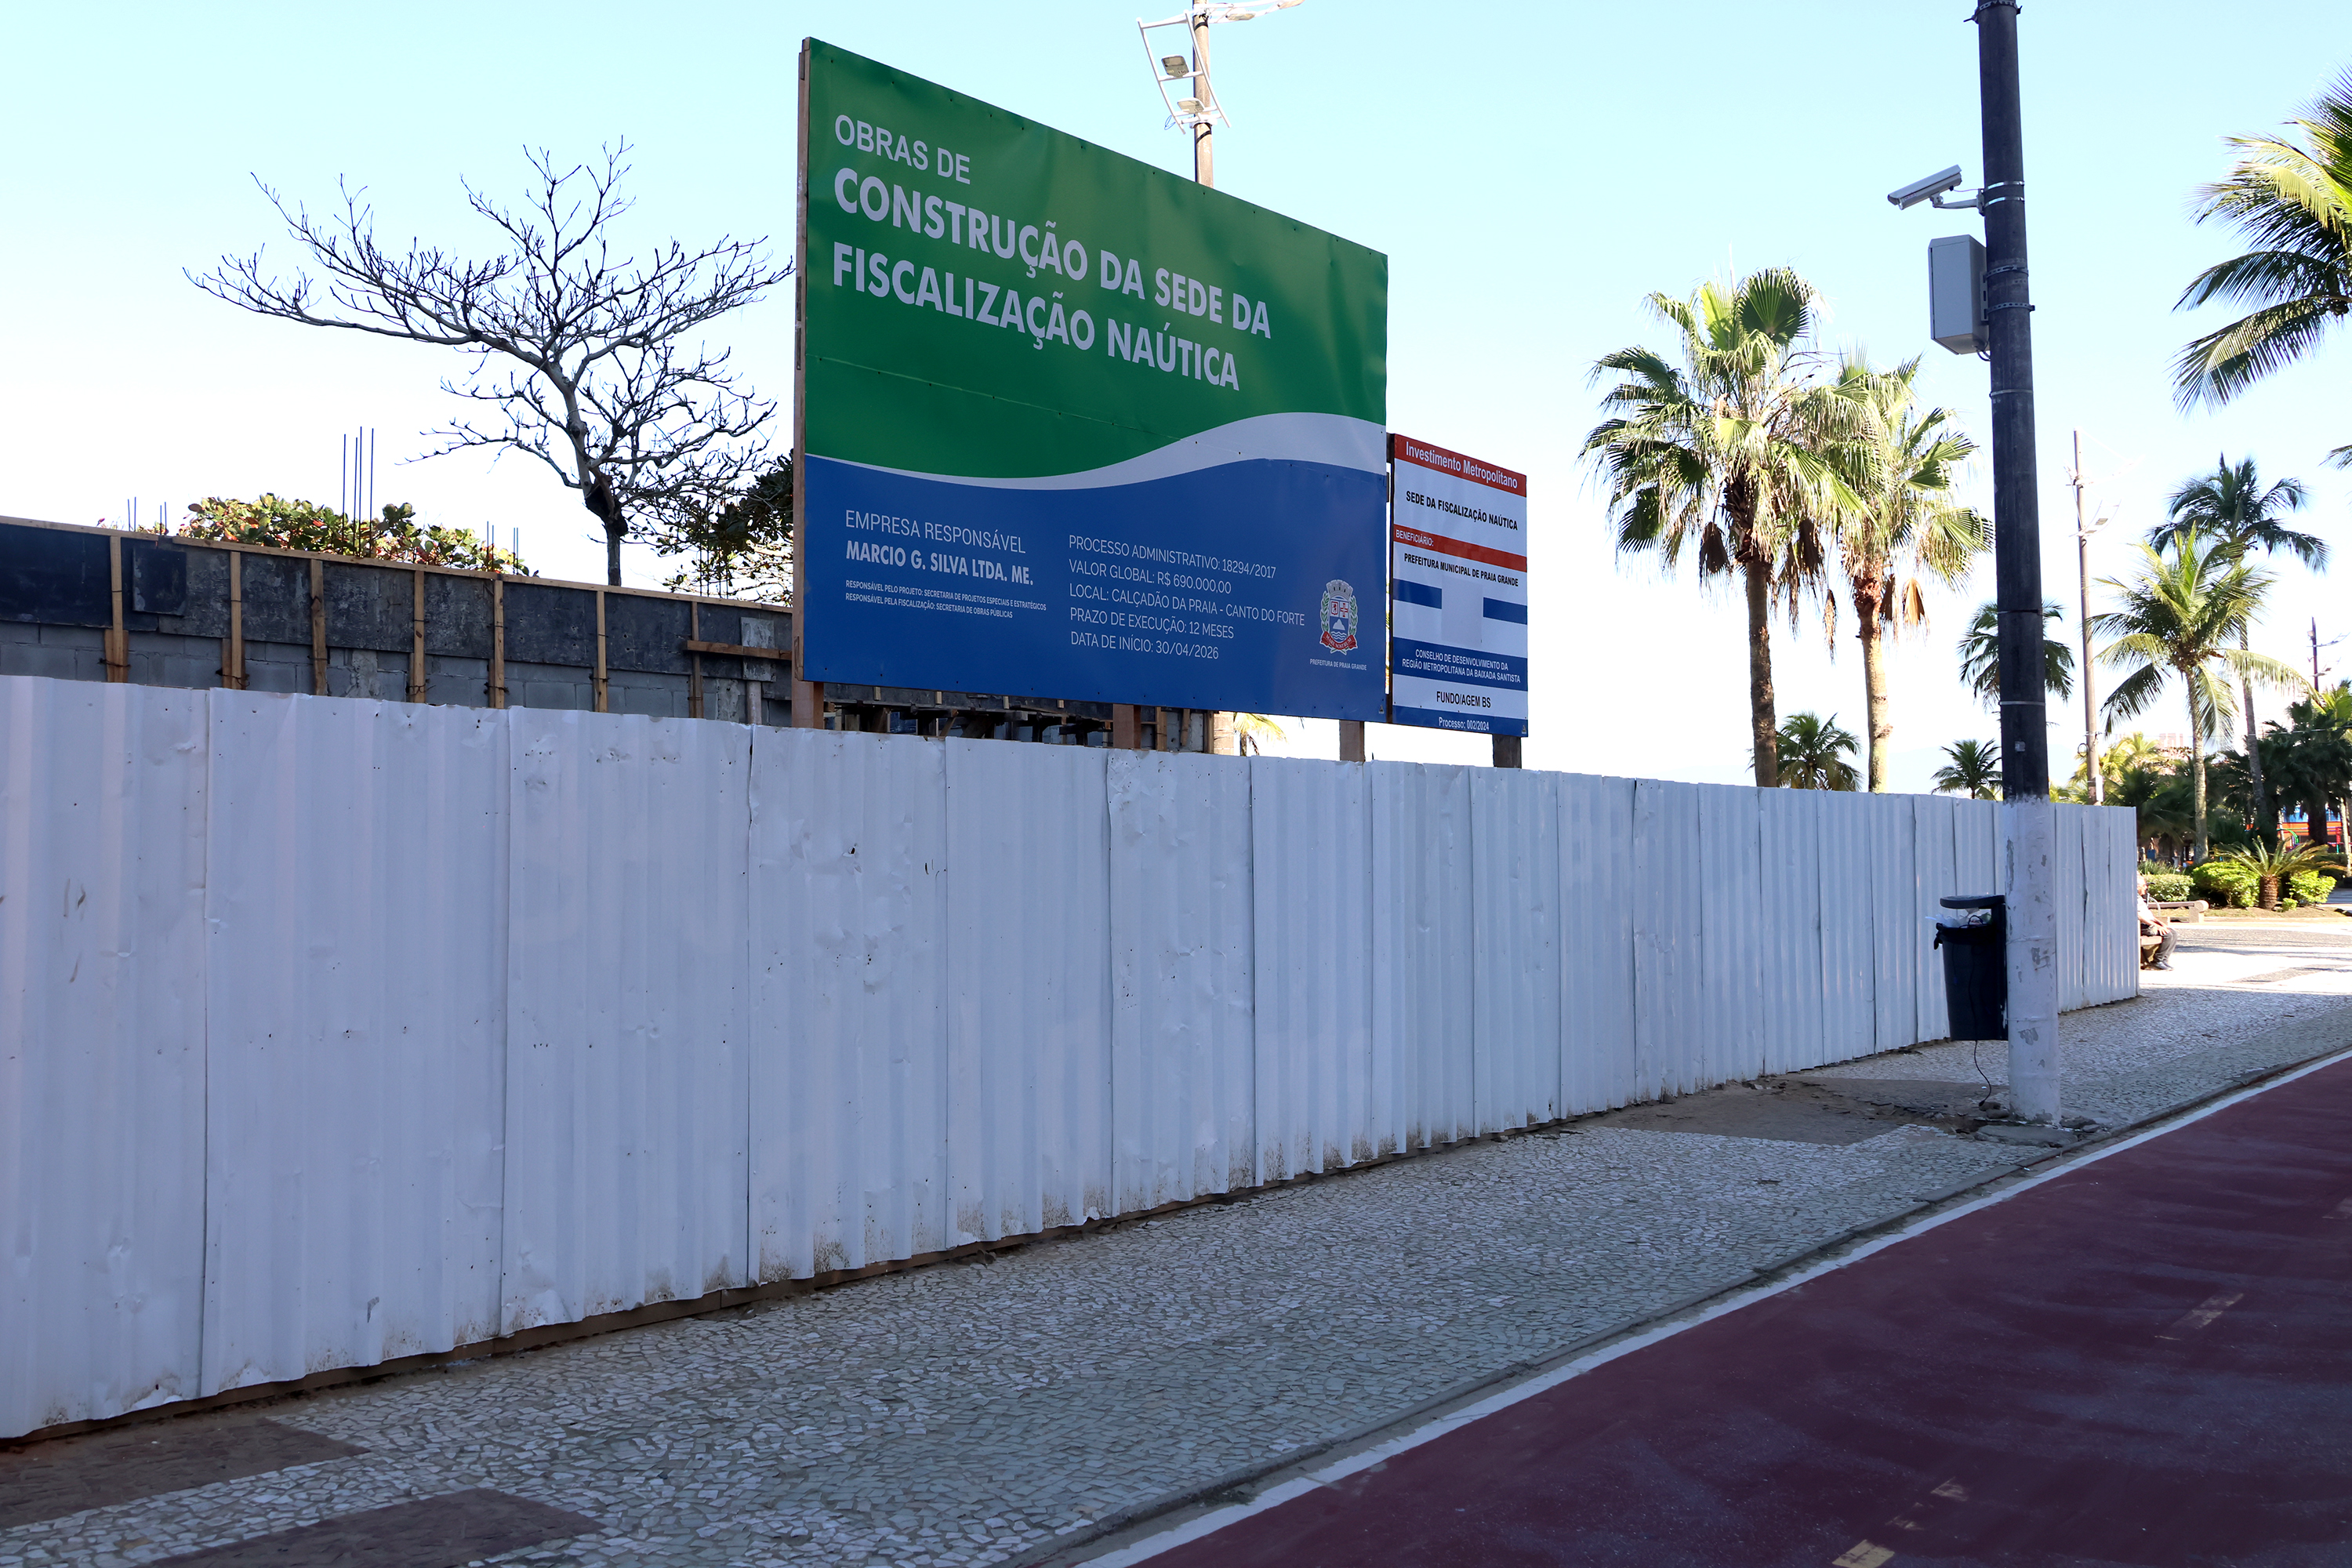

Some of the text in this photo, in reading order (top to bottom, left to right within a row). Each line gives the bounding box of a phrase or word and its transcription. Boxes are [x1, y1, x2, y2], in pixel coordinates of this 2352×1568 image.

[835, 114, 971, 184] OBRAS DE
[834, 167, 1271, 339] CONSTRUÇÃO DA SEDE DA
[834, 241, 1240, 391] FISCALIZAÇÃO NAÚTICA
[1406, 441, 1518, 488] Investimento Metropolitano
[1406, 491, 1518, 530] SEDE DA FISCALIZAÇÃO NAÚTICA
[846, 510, 1025, 554] EMPRESA RESPONSÁVEL
[1396, 529, 1434, 546] BENEFICIÁRIO:
[846, 540, 1033, 585] MARCIO G. SILVA LTDA. ME.
[1069, 535, 1276, 579] PROCESSO ADMINISTRATIVO: 18294/2017
[1404, 553, 1519, 586] PREFEITURA MUNICIPAL DE PRAIA GRANDE
[1069, 559, 1231, 594] VALOR GLOBAL: R$ 690.000,00
[846, 580, 884, 591] RESPONSÁVEL
[884, 584, 898, 593] PELO
[899, 586, 923, 596] PROJETO:
[924, 590, 953, 600] SECRETARIA
[962, 593, 985, 604] PROJETOS
[987, 597, 1010, 606] ESPECIAIS
[1014, 601, 1047, 611] ESTRATÉGICOS
[846, 593, 884, 604] RESPONSÁVEL
[884, 597, 897, 605] PELA
[898, 598, 935, 610] FISCALIZAÇÃO:
[936, 603, 965, 613] SECRETARIA
[974, 607, 989, 615] OBRAS
[990, 608, 1013, 618] PÚBLICAS
[1069, 583, 1109, 601] LOCAL:
[1112, 588, 1169, 608] CALÇADÃO
[1172, 596, 1186, 611] DA
[1189, 598, 1218, 614] PRAIA
[1225, 604, 1258, 619] CANTO
[1261, 608, 1275, 622] DO
[1277, 611, 1305, 626] FORTE
[1070, 607, 1234, 639] PRAZO DE EXECUÇÃO: 12 MESES
[1071, 631, 1219, 659] DATA DE INÍCIO: 30/04/2026
[1415, 648, 1508, 671] CONSELHO DE DESENVOLVIMENTO DA
[1402, 659, 1520, 683] REGIÃO METROPOLITANA DA BAIXADA SANTISTA
[1436, 691, 1491, 708] FUNDO/AGEM BS
[1439, 717, 1490, 731] Processo: 002/2024
